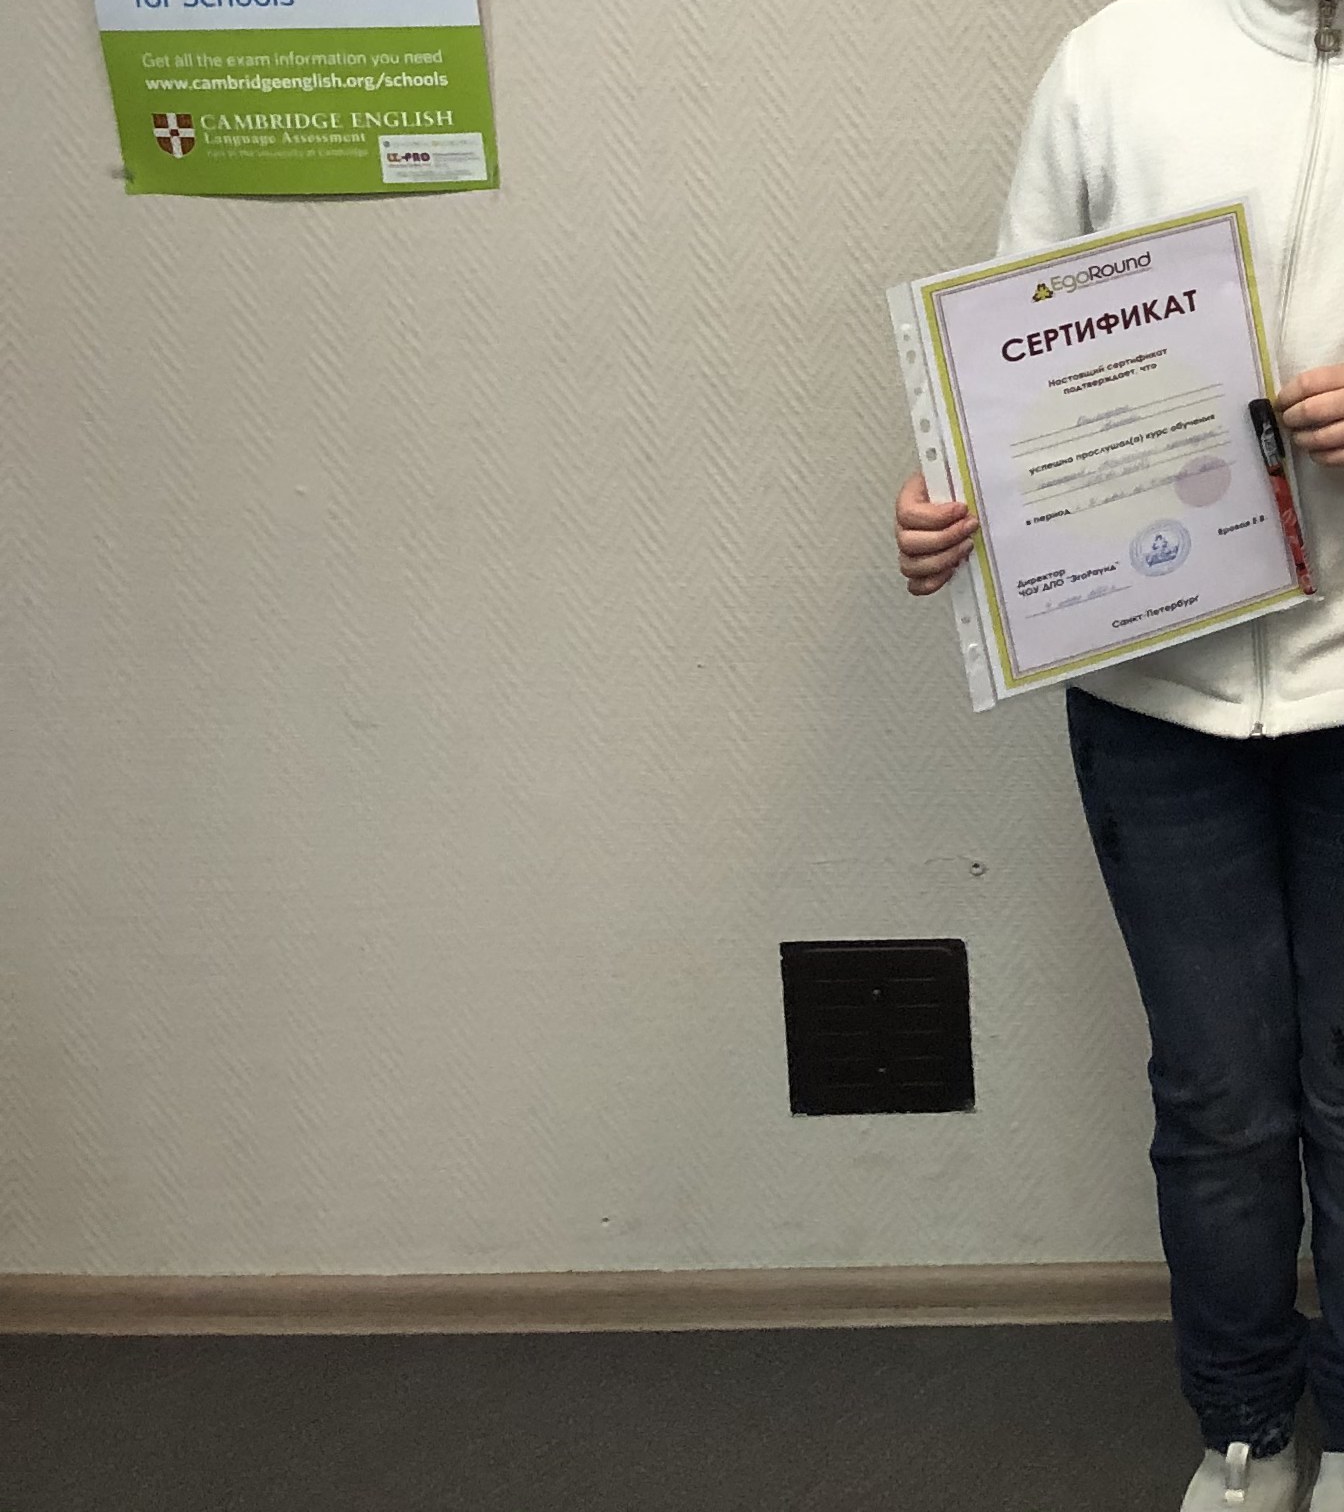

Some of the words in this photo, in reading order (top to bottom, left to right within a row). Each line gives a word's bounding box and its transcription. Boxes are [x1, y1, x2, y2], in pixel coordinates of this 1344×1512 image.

[143, 53, 170, 68] Get
[175, 53, 192, 67] all
[197, 53, 222, 67] the
[227, 55, 270, 67] exam
[274, 52, 367, 66] information
[372, 53, 399, 68] you
[404, 50, 442, 64] need
[146, 71, 448, 93] www.cambridgeenglish.org/schools
[201, 114, 340, 130] CAMBRIDGE
[352, 111, 453, 127] ENGLISH
[204, 132, 276, 147] Language
[282, 132, 366, 144] Assessment
[1051, 251, 1152, 294] EgoRound
[1001, 289, 1197, 363] СЕРТИФИКАТ
